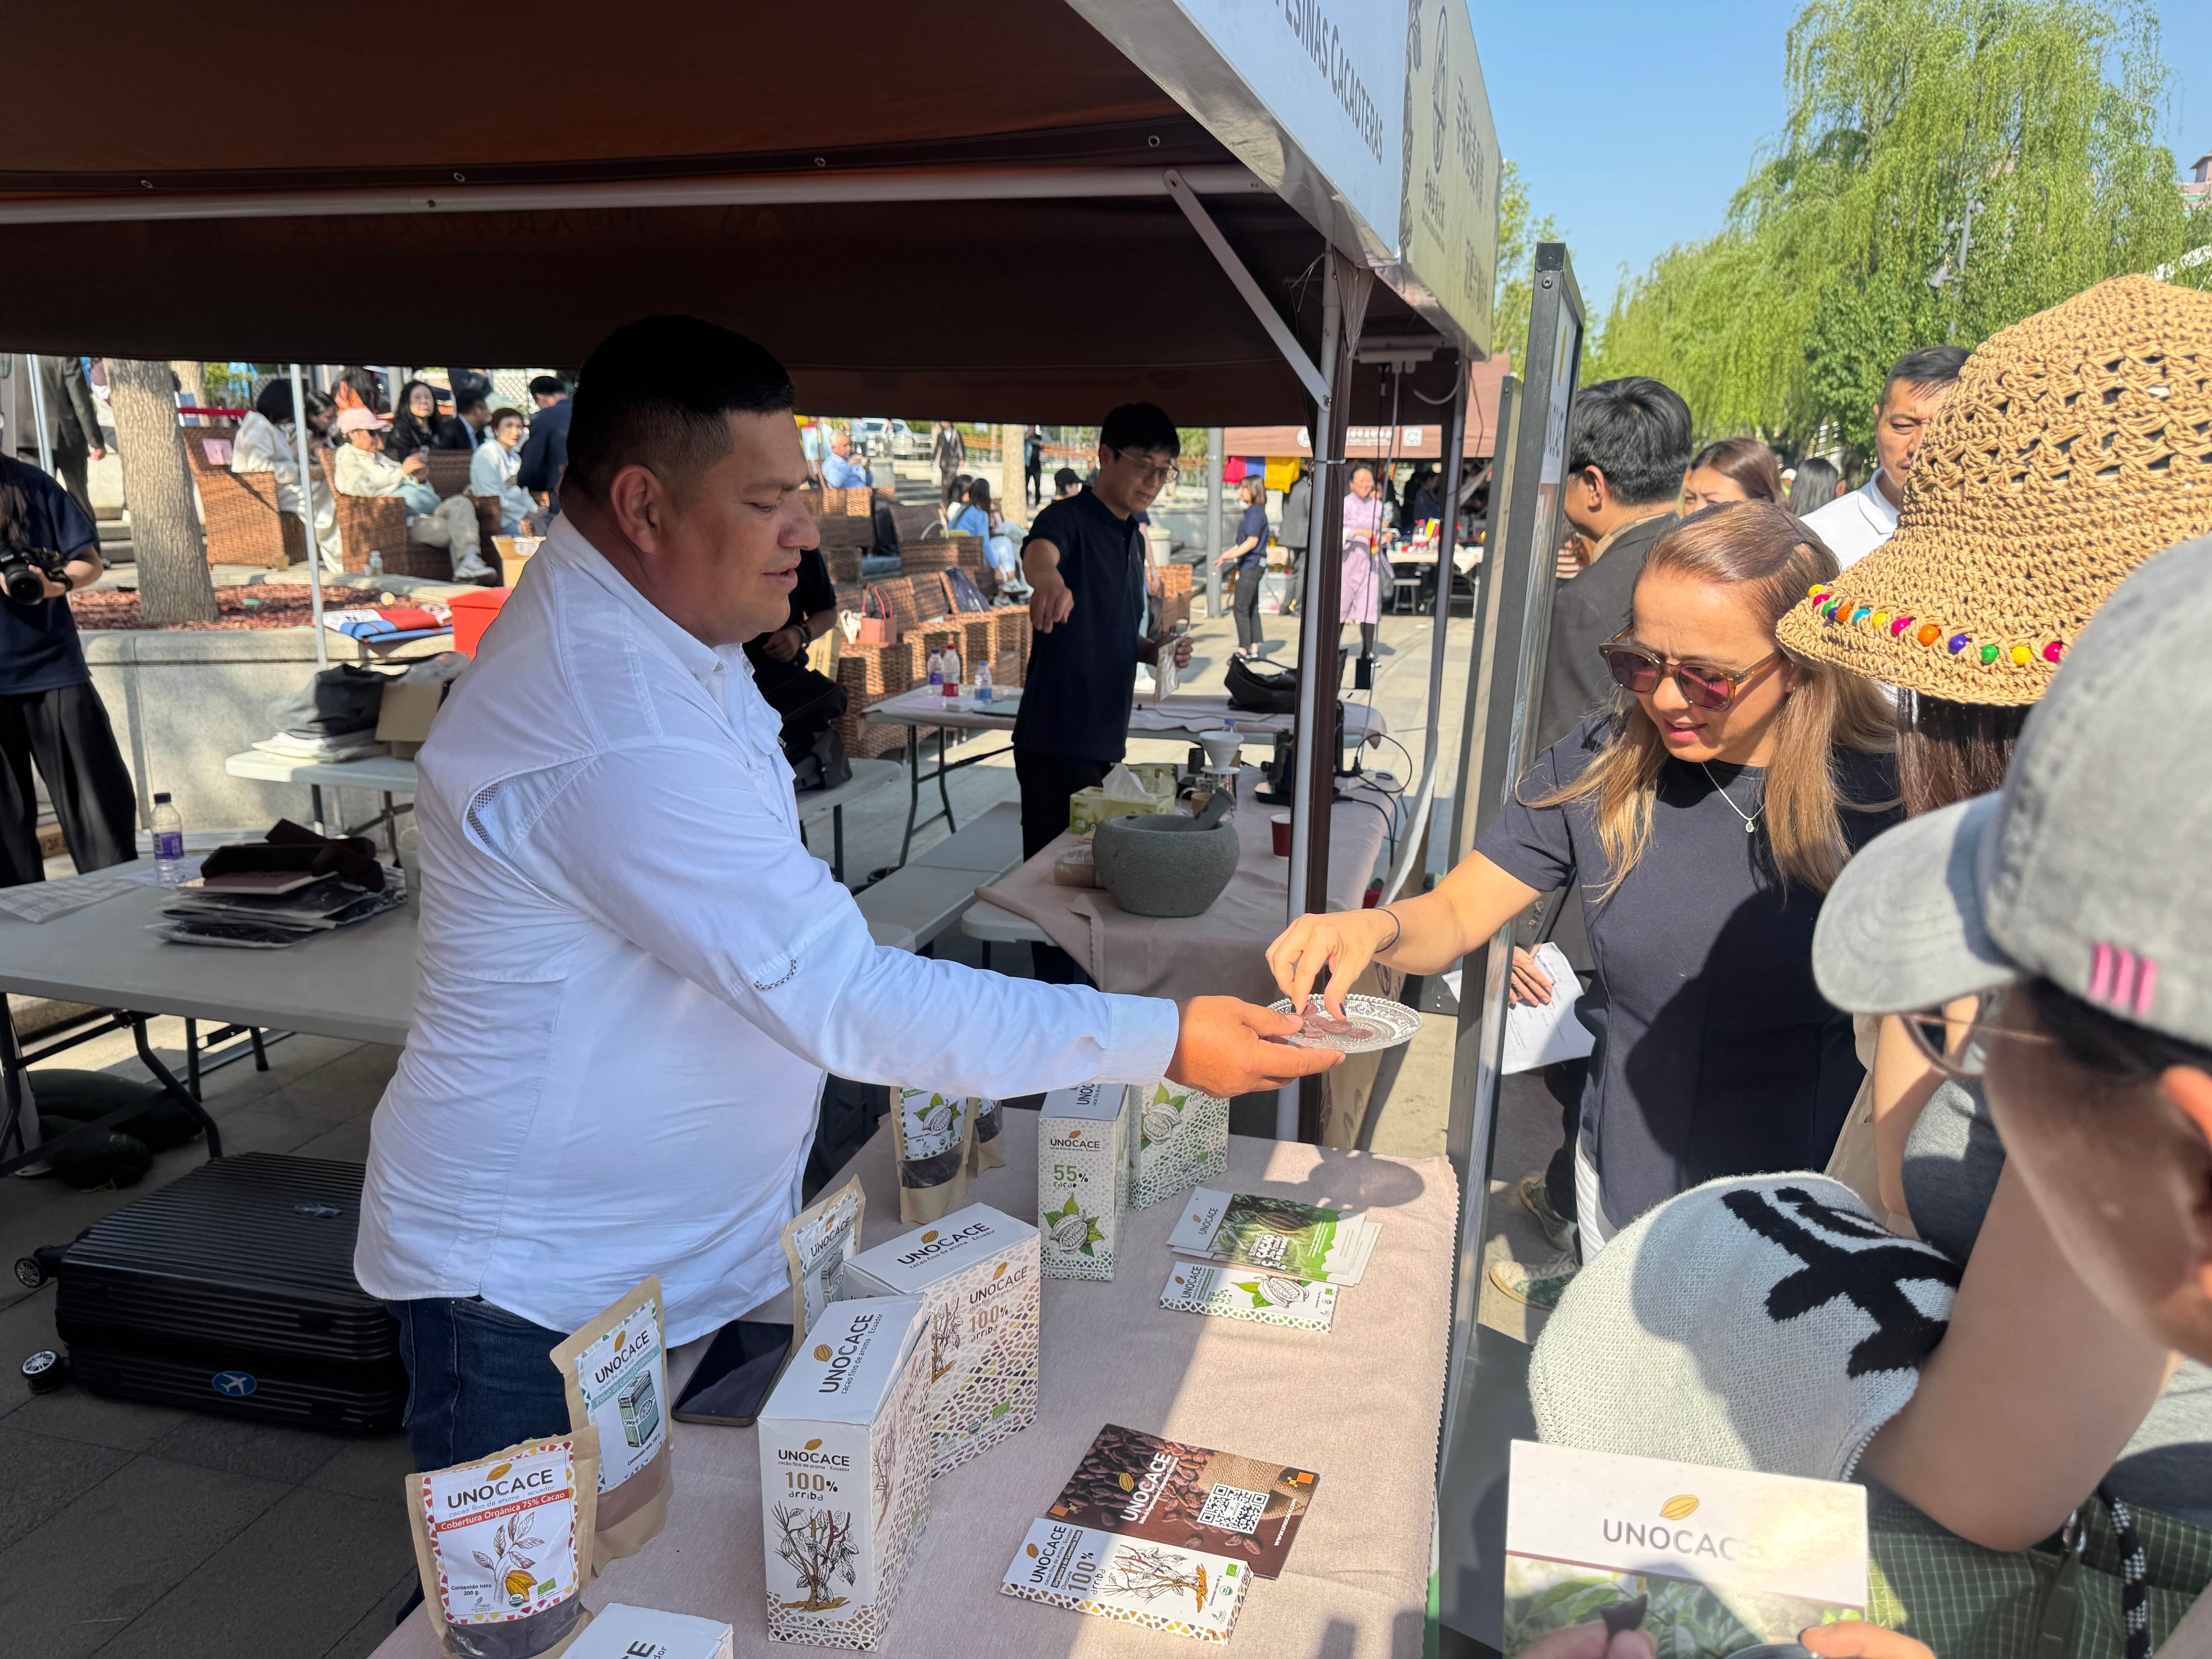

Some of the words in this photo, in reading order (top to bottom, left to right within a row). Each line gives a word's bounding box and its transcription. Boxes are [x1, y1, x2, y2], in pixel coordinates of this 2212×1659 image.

[1331, 24, 1383, 165] CACAOTERAS
[1050, 1138, 1100, 1149] UNOCACE
[1054, 1164, 1089, 1182] 55%
[811, 1216, 851, 1257] UNOCACE
[1198, 1207, 1218, 1235] UNOCACE
[896, 1223, 991, 1264] UNOCACE
[910, 1259, 927, 1269] cacao
[950, 1241, 968, 1251] aroma
[971, 1230, 995, 1241] Ecuador
[1255, 1234, 1274, 1258] CACAO
[969, 1265, 1028, 1304] UNOCACE
[1181, 1266, 1202, 1298] UNOCACE
[970, 1304, 1008, 1333] 100%
[971, 1324, 998, 1342] arriba
[595, 1330, 650, 1384] UNOCACE
[818, 1314, 874, 1393] UNOCACE
[841, 1377, 853, 1394] cacao
[847, 1365, 859, 1376] fino
[855, 1355, 863, 1364] de
[860, 1338, 871, 1356] aroma
[868, 1314, 883, 1334] Ecuador
[596, 1390, 612, 1405] Polvo
[612, 1383, 619, 1392] de
[619, 1371, 634, 1388] cacao
[633, 1352, 654, 1372] Orgánico
[627, 1449, 646, 1466] Contenido
[778, 1449, 850, 1467] UNOCACE
[934, 1449, 960, 1465] Contenido
[981, 1428, 995, 1439] Barras
[448, 1469, 554, 1509] UNOCACE
[785, 1471, 838, 1492] 100%
[788, 1491, 823, 1501] arriba
[1120, 1452, 1172, 1521] UNOCACE
[441, 1515, 483, 1530] Cobertura
[484, 1504, 521, 1519] Orgánica
[522, 1499, 539, 1509] 75%
[541, 1492, 565, 1503] Cacao
[449, 1508, 470, 1518] cacao
[498, 1495, 520, 1504] aroma
[1029, 1525, 1067, 1583] UNOCACE
[1602, 1518, 1740, 1561] UNOCAC
[1044, 1571, 1053, 1585] cacao
[1056, 1546, 1065, 1559] aroma
[1061, 1571, 1073, 1590] Chocolate
[1068, 1552, 1097, 1592] 100%
[1091, 1568, 1106, 1595] arriba
